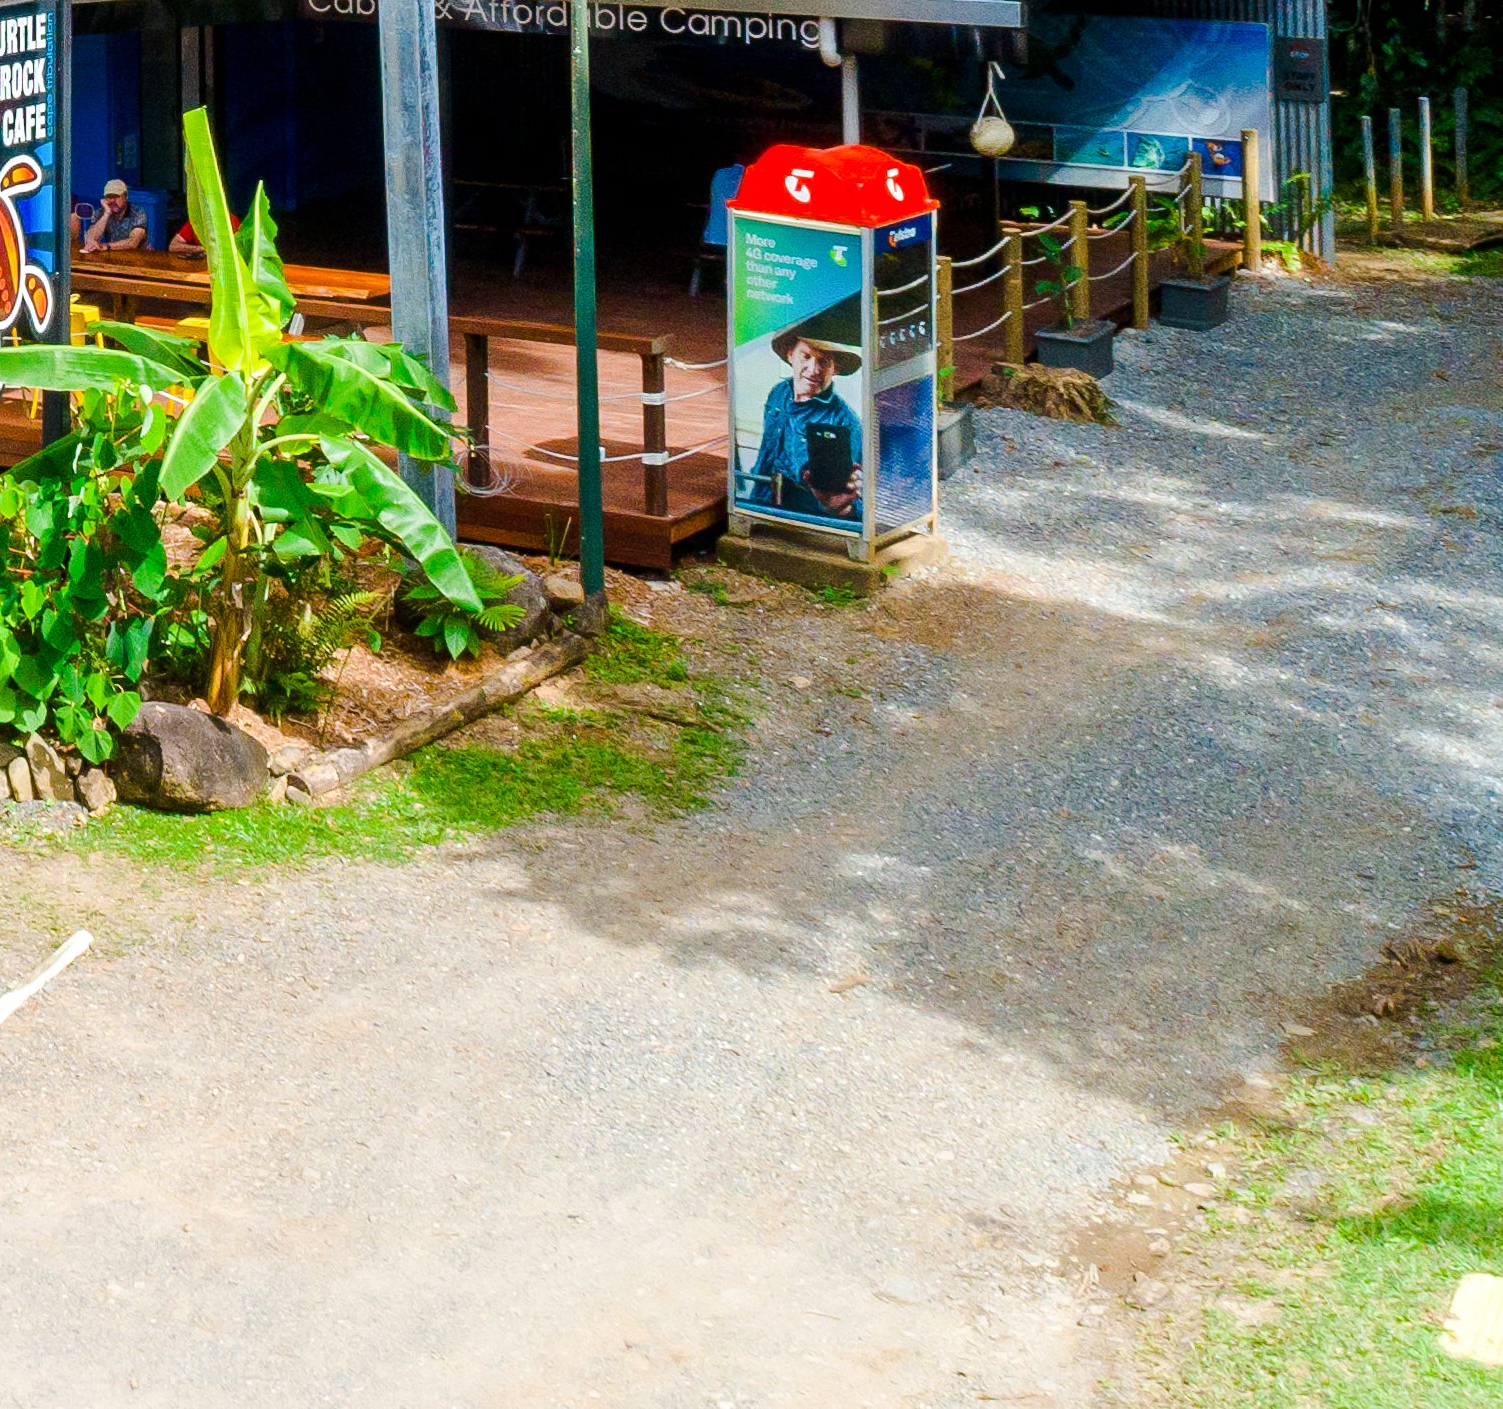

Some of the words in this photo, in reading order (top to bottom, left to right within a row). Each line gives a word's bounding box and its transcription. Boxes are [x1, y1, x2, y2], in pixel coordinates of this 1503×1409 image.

[660, 6, 821, 49] Camping
[2, 102, 47, 147] CAFE
[745, 232, 776, 248] More
[745, 247, 762, 260] 4G
[763, 251, 818, 270] coverage
[746, 260, 773, 274] than
[774, 266, 797, 281] any
[746, 275, 779, 290] other
[747, 289, 794, 305] network
